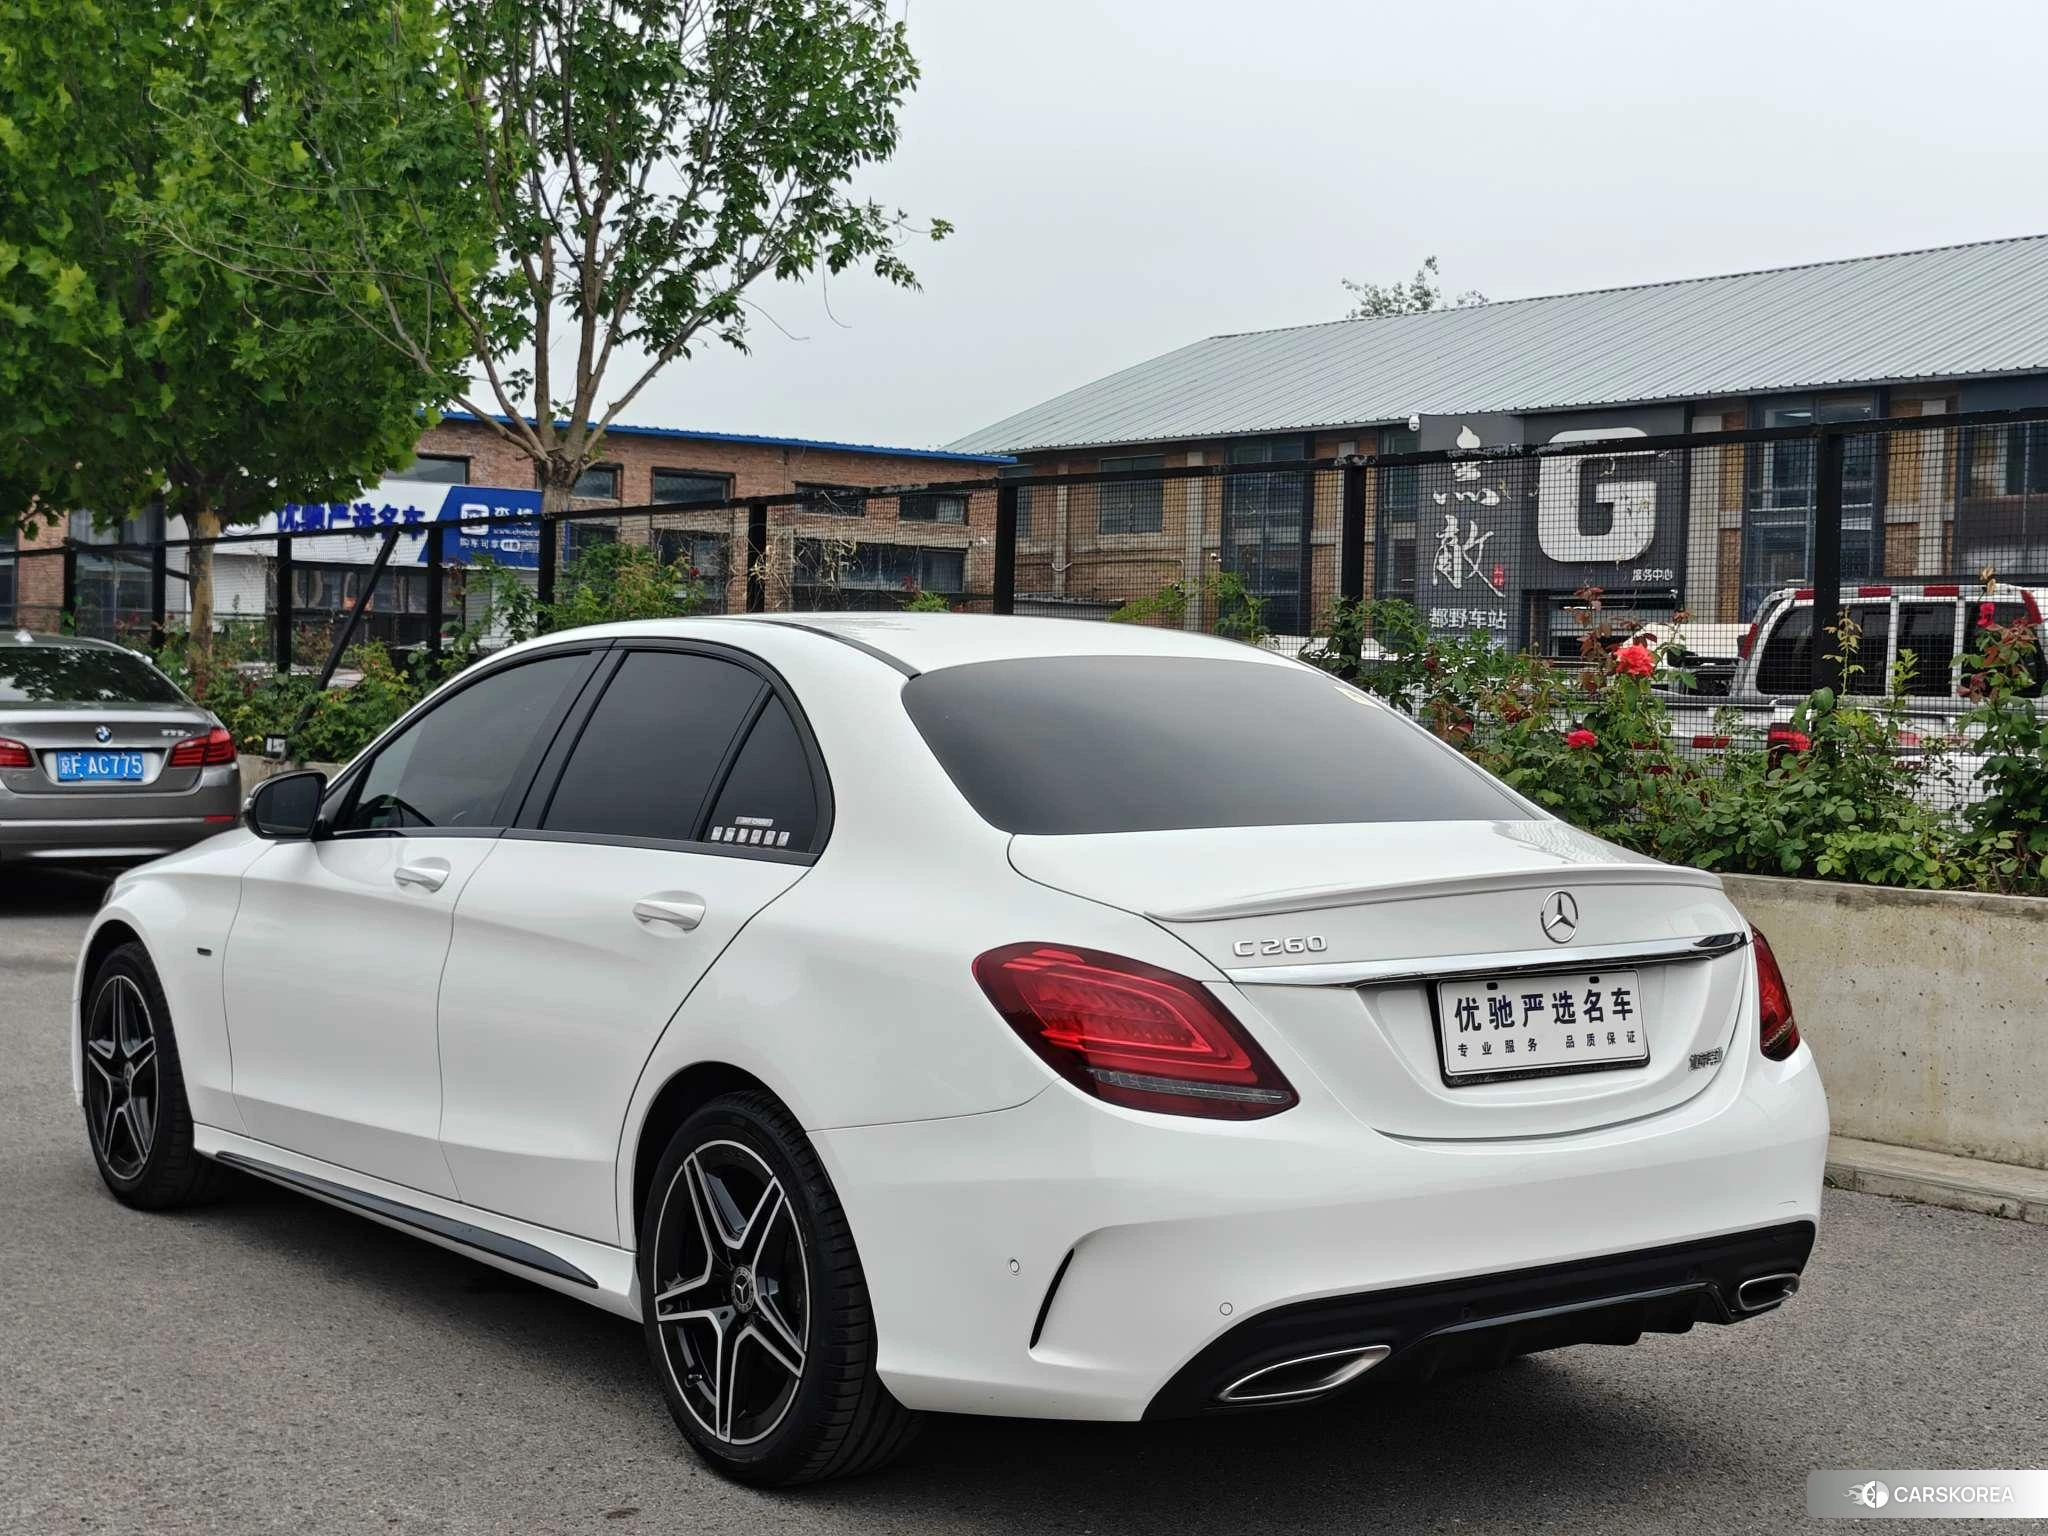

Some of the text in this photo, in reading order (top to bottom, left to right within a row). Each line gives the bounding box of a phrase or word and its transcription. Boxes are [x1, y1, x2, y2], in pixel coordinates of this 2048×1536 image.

[1537, 426, 1657, 563] G
[1632, 567, 1673, 582] 服务中心
[1232, 934, 1328, 958] C 260
[1454, 987, 1634, 1033] 优驰严选名车
